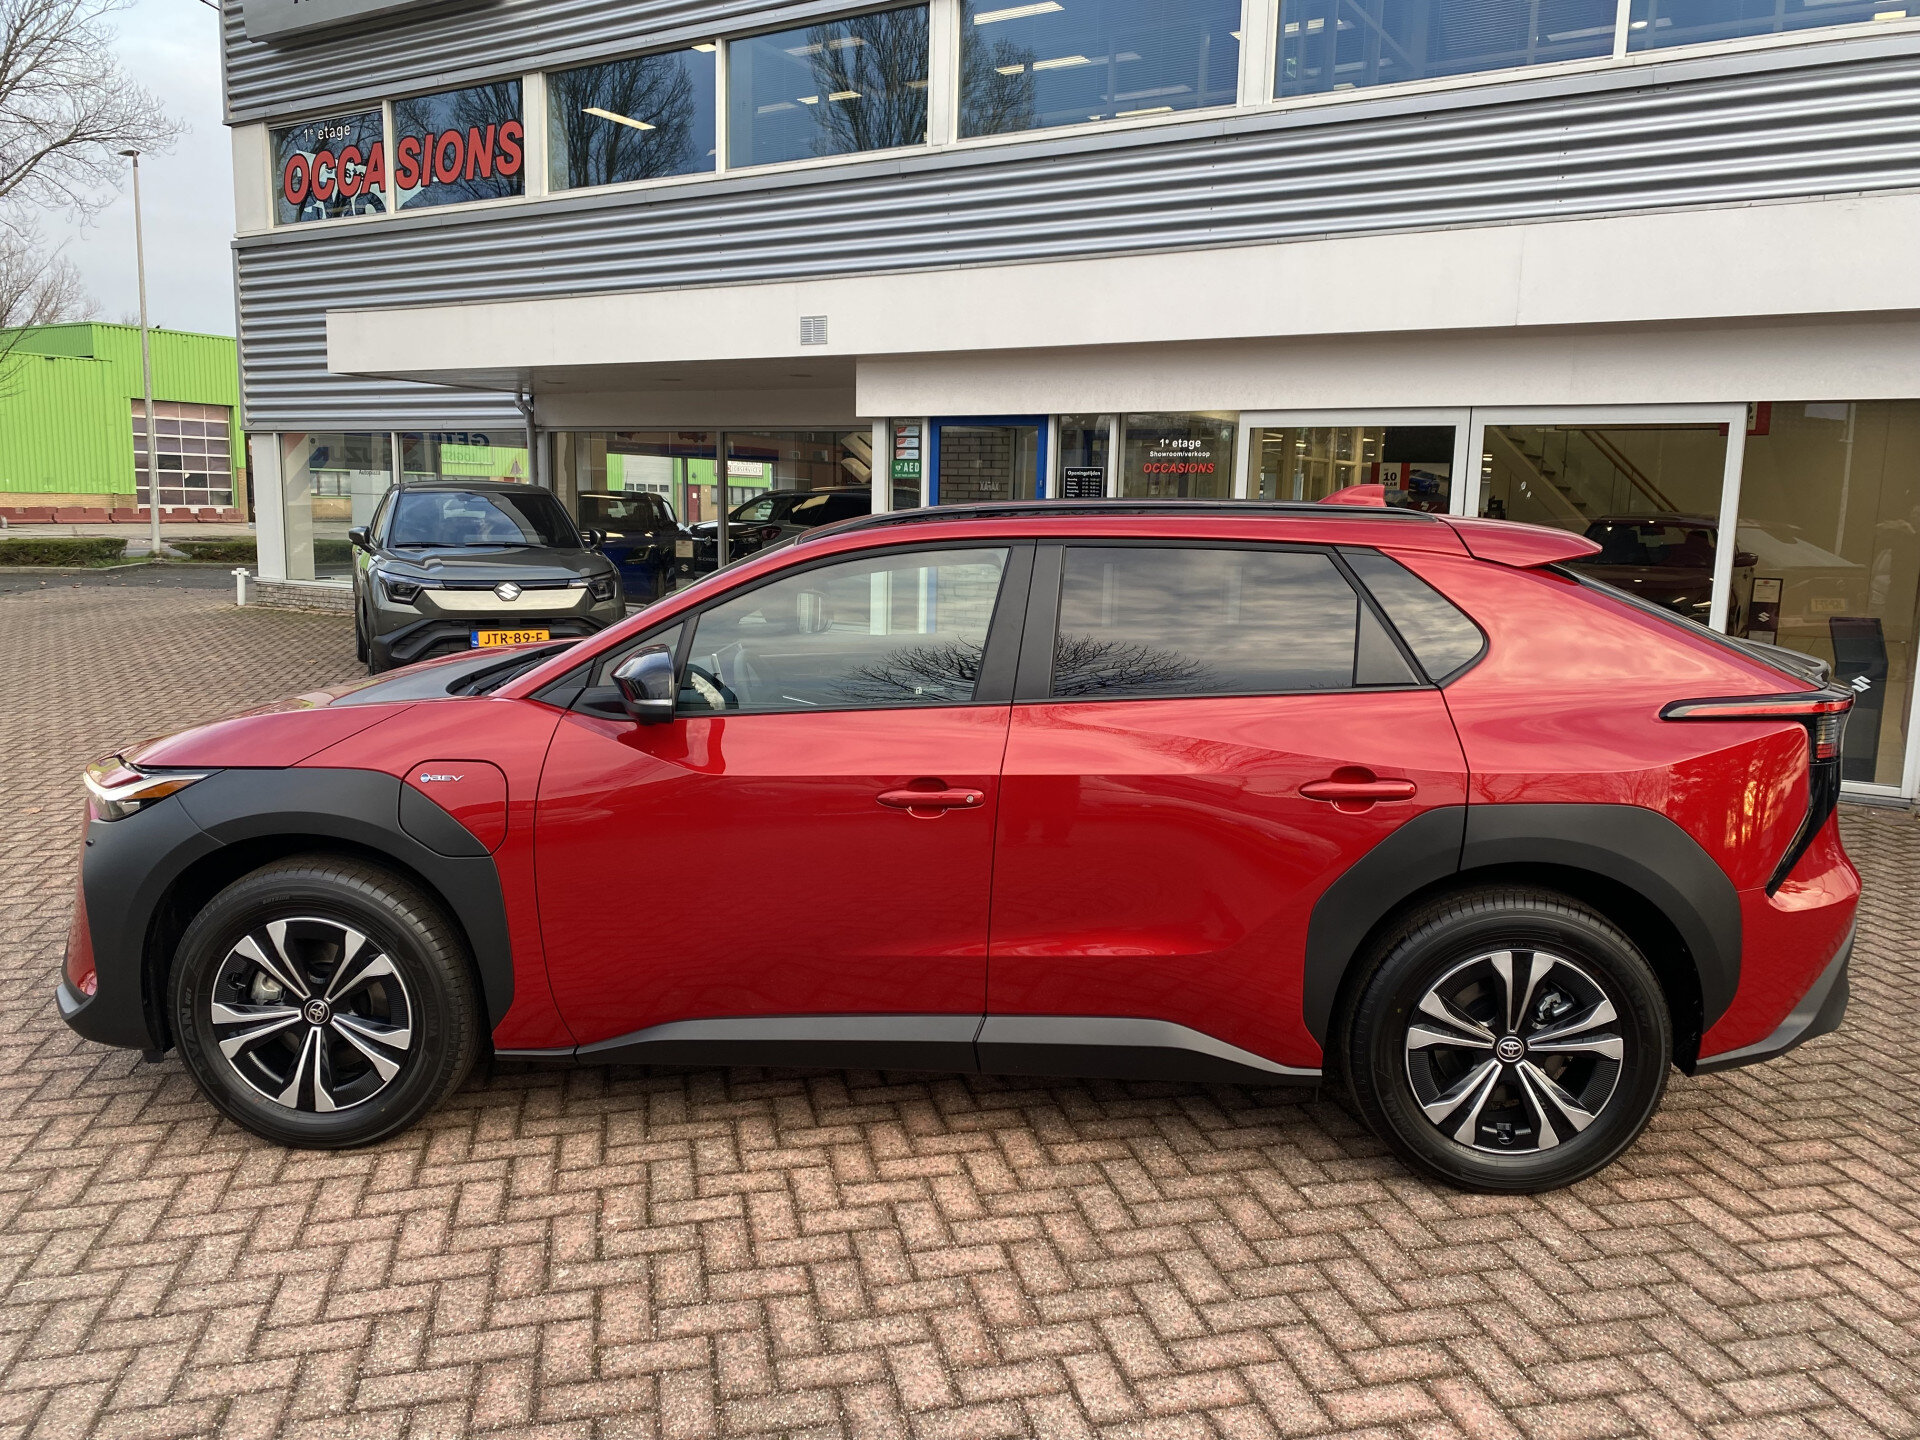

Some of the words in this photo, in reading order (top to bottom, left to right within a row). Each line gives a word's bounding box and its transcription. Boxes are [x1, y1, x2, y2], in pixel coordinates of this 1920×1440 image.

[317, 123, 351, 141] etage
[283, 120, 524, 205] OCCASIONS
[1172, 438, 1202, 450] etage
[903, 462, 920, 473] AED
[1143, 462, 1215, 474] OCCASIONS
[1383, 472, 1398, 481] 10
